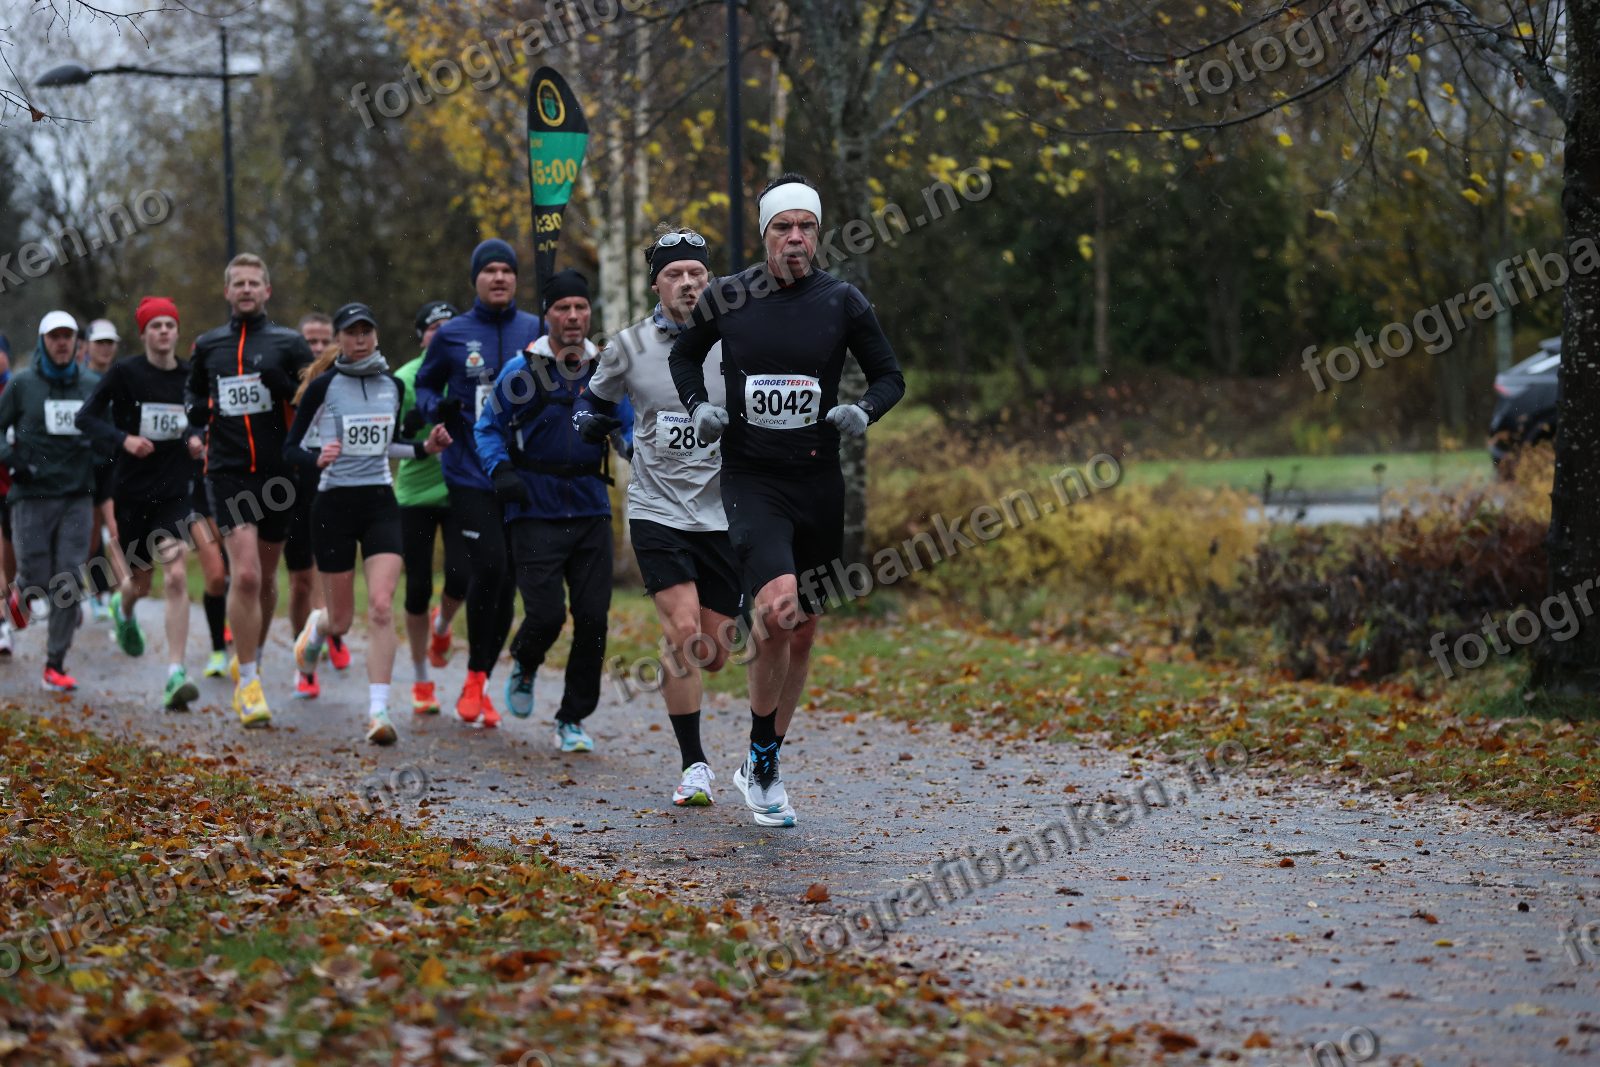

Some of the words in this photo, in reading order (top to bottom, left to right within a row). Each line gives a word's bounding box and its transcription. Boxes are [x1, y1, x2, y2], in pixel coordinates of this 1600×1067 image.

[228, 385, 260, 406] 385
[752, 389, 814, 416] 3042
[152, 414, 179, 432] 165
[348, 425, 389, 446] 9361
